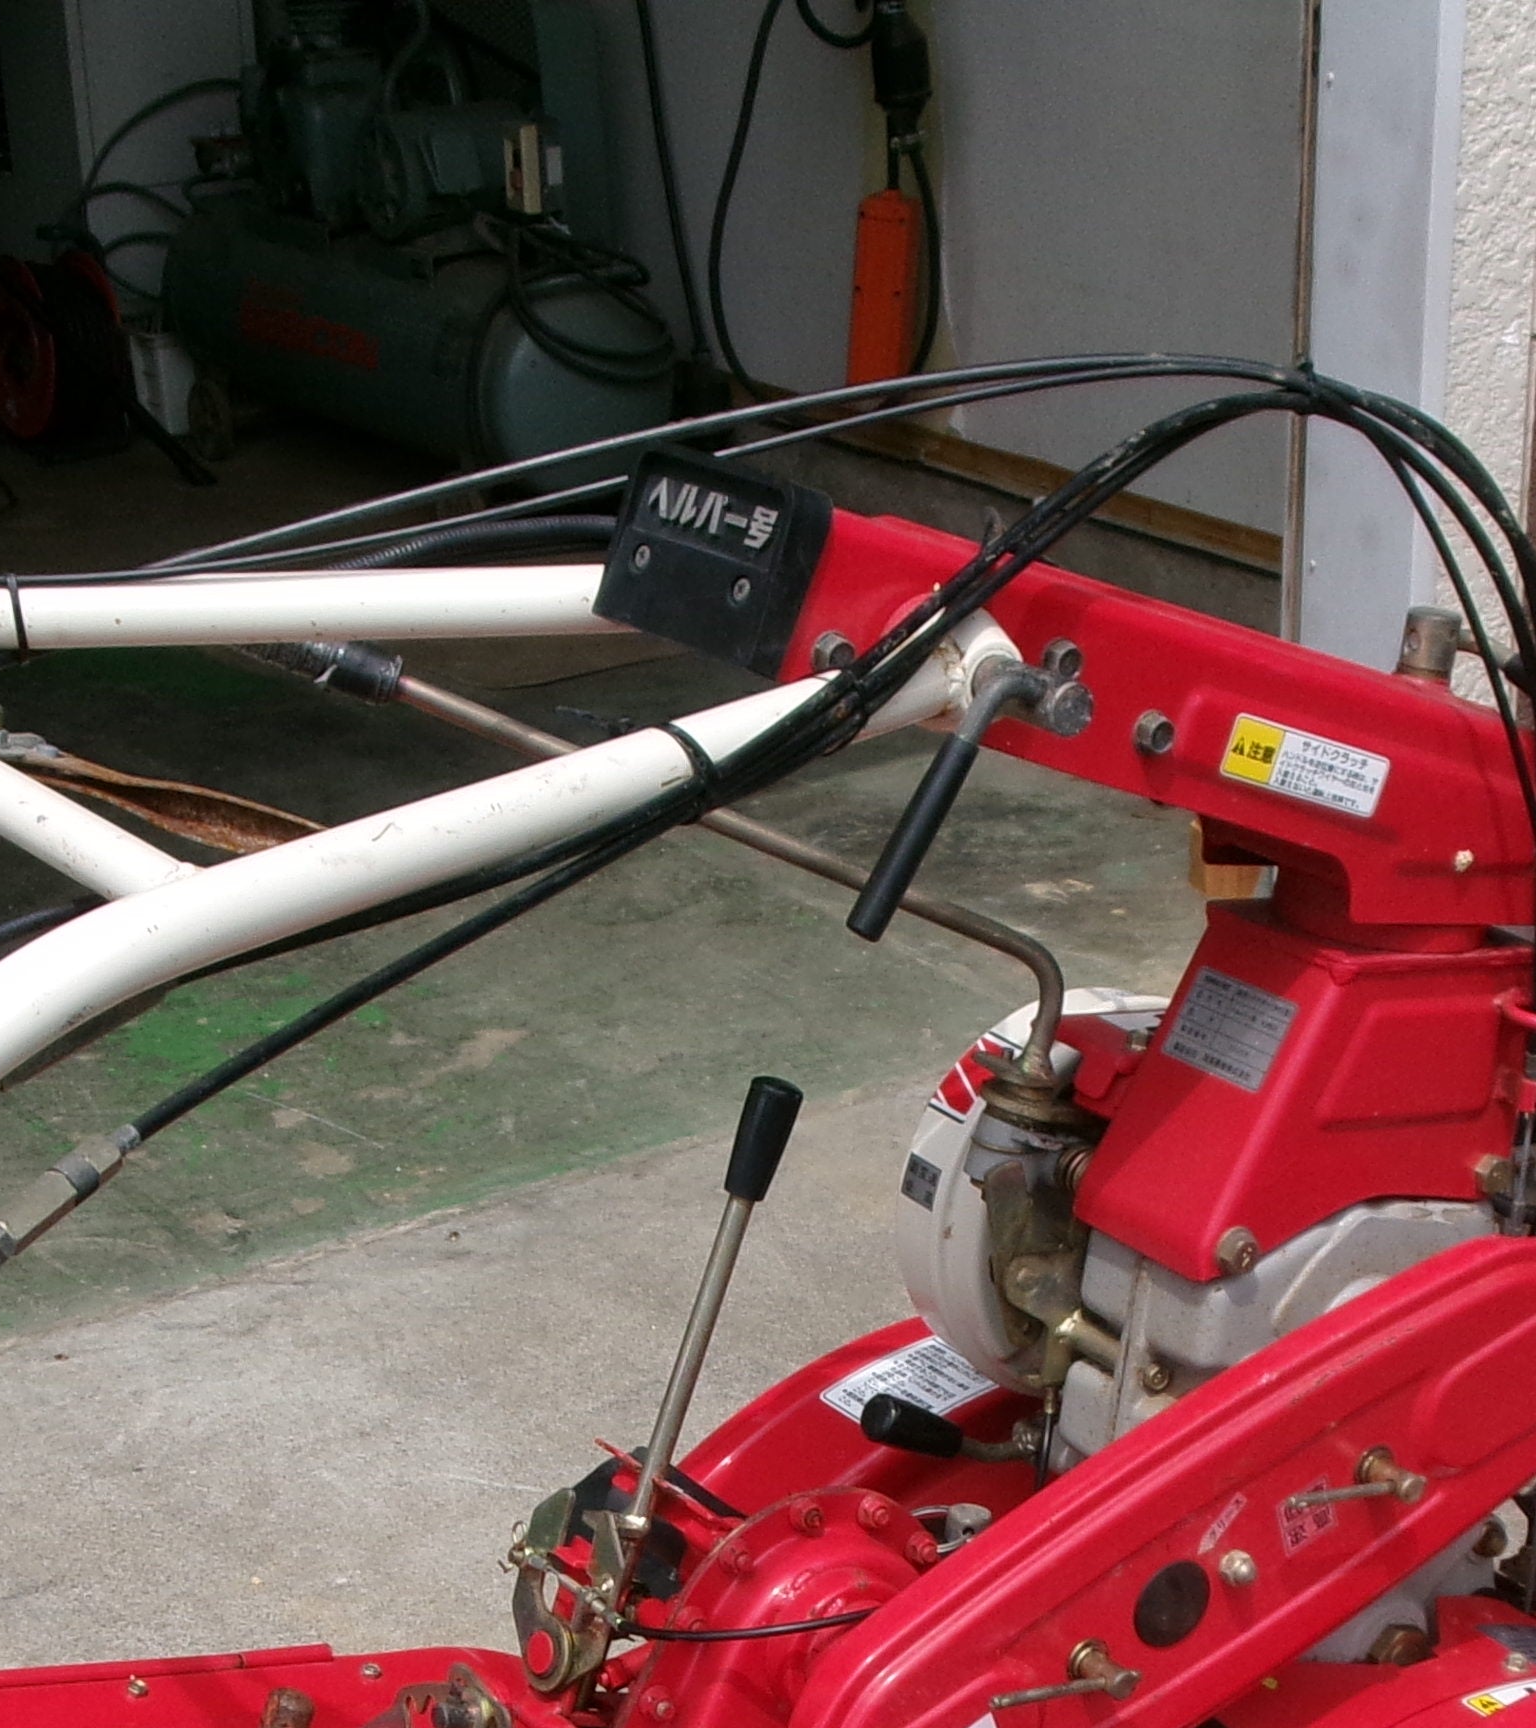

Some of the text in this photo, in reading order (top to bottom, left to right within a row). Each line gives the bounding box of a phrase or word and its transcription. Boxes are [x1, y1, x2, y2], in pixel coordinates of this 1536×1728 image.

[648, 476, 779, 549] ヘルパー号
[1246, 740, 1276, 764] 注意
[1301, 740, 1368, 770] サイドクラッチ
